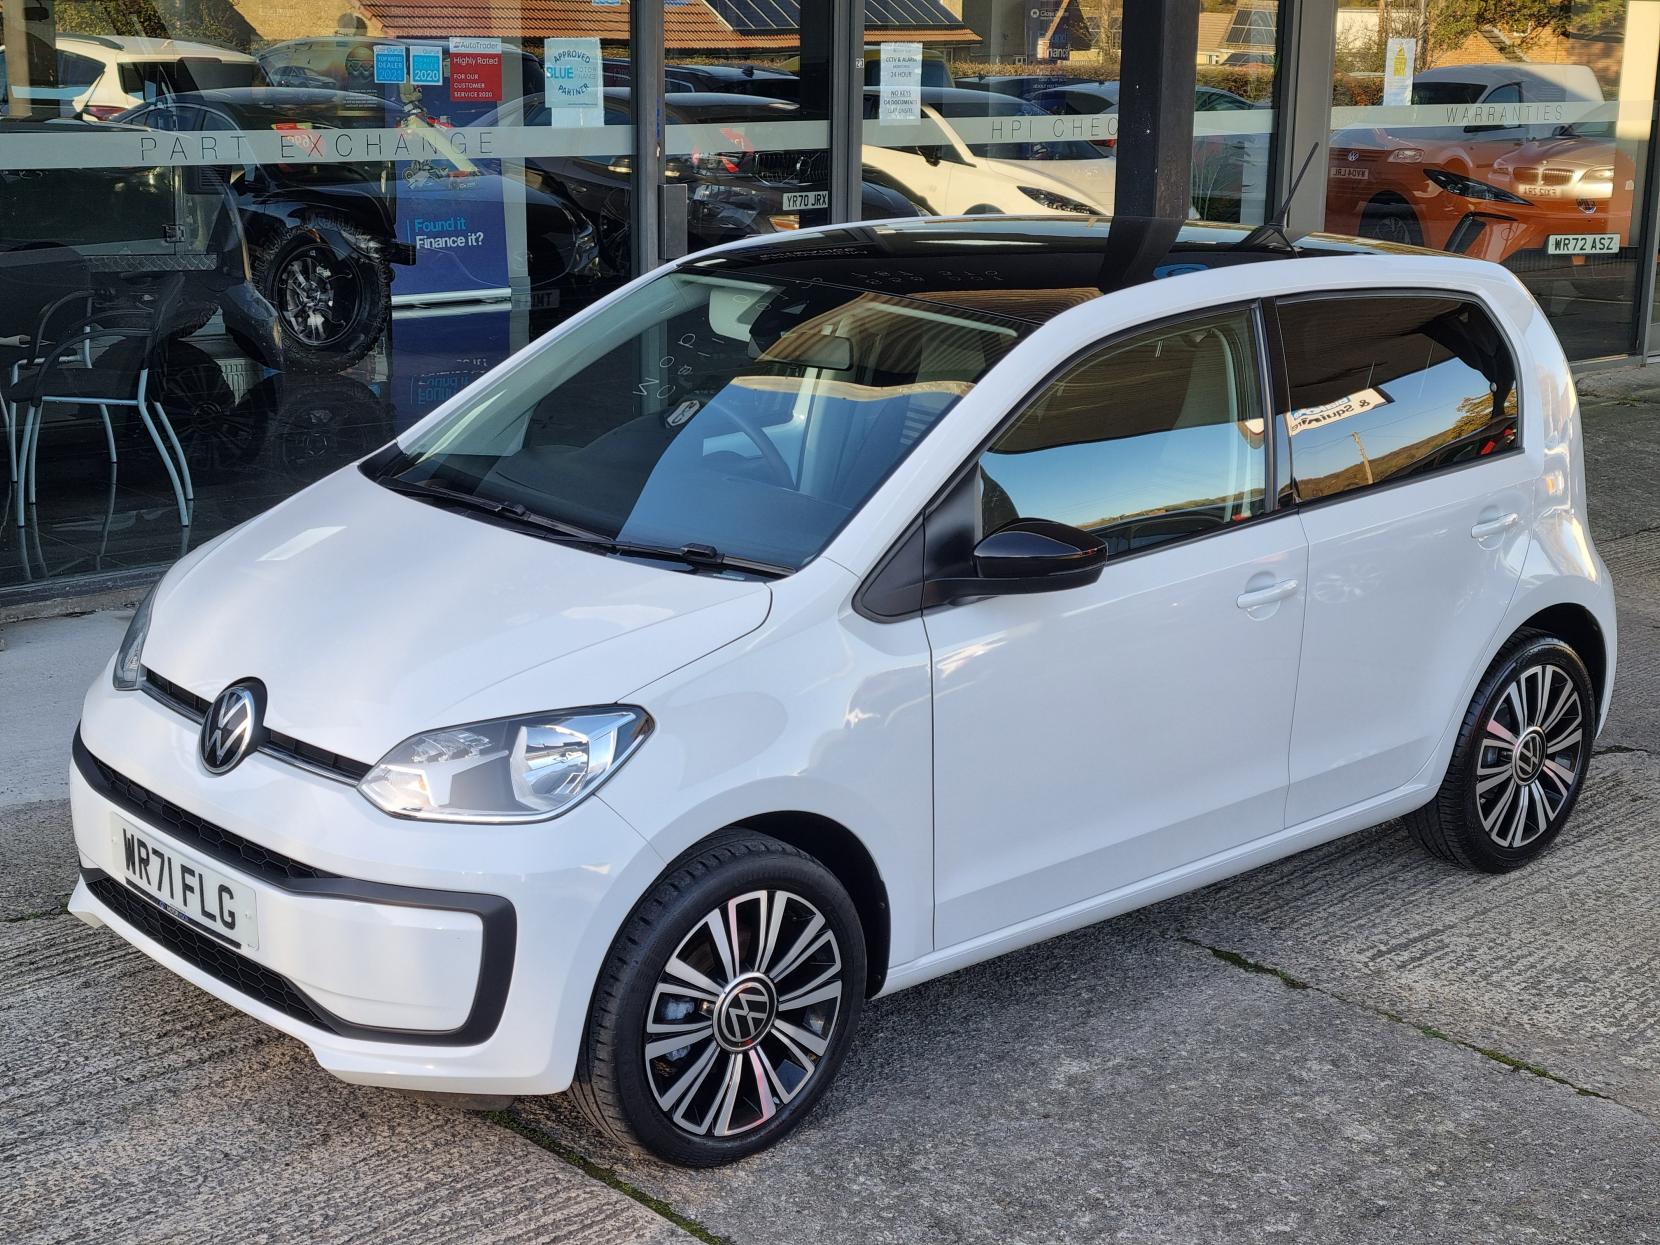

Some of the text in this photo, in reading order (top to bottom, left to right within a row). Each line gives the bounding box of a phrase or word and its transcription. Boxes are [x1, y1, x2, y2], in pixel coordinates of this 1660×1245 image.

[460, 41, 498, 49] AutoTrader
[453, 56, 499, 67] Highly Rated
[553, 49, 591, 64] APPROVED
[414, 70, 439, 81] 2020
[546, 65, 574, 80] BLUE
[558, 82, 590, 97] PARTNER
[1446, 104, 1563, 123] WARRANTIES
[991, 119, 1033, 139] HPI
[139, 135, 246, 161] PART
[280, 130, 493, 159] EXCHANGE
[787, 193, 827, 208] YR70 JRX
[415, 216, 466, 232] Found it
[415, 231, 484, 250] Finance it?
[1554, 237, 1614, 252] WR72 ASZ
[122, 827, 236, 931] WR71 FLG
